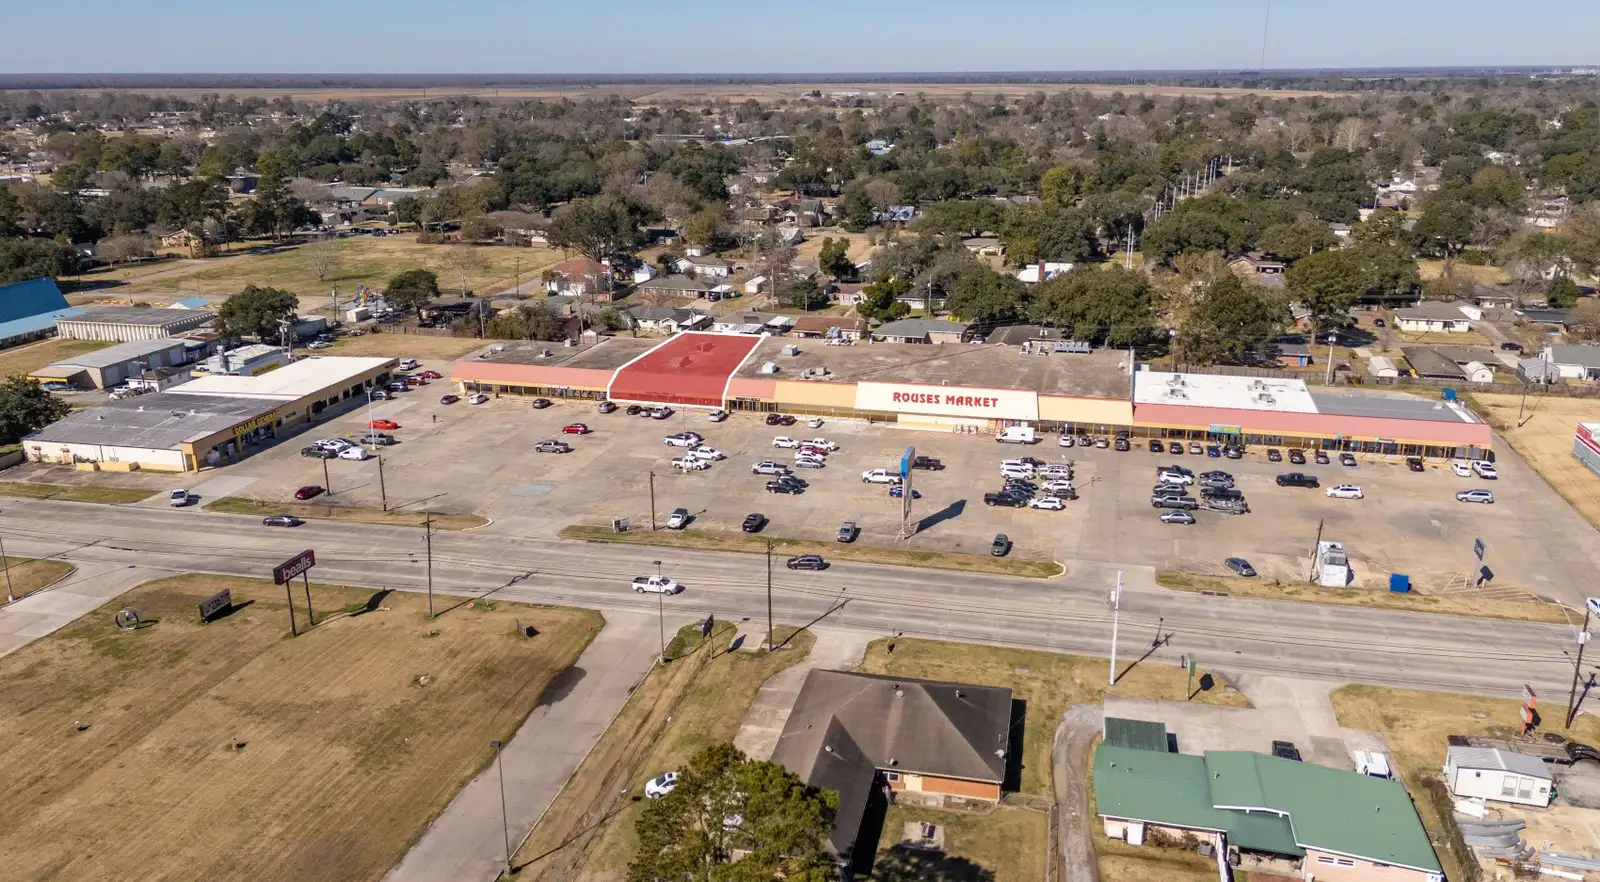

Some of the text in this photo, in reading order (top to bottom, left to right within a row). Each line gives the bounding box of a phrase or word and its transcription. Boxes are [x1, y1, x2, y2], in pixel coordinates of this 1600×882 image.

[893, 392, 998, 407] ROUSES MARKET
[234, 419, 256, 436] DOLLAR
[282, 556, 312, 582] bealls
